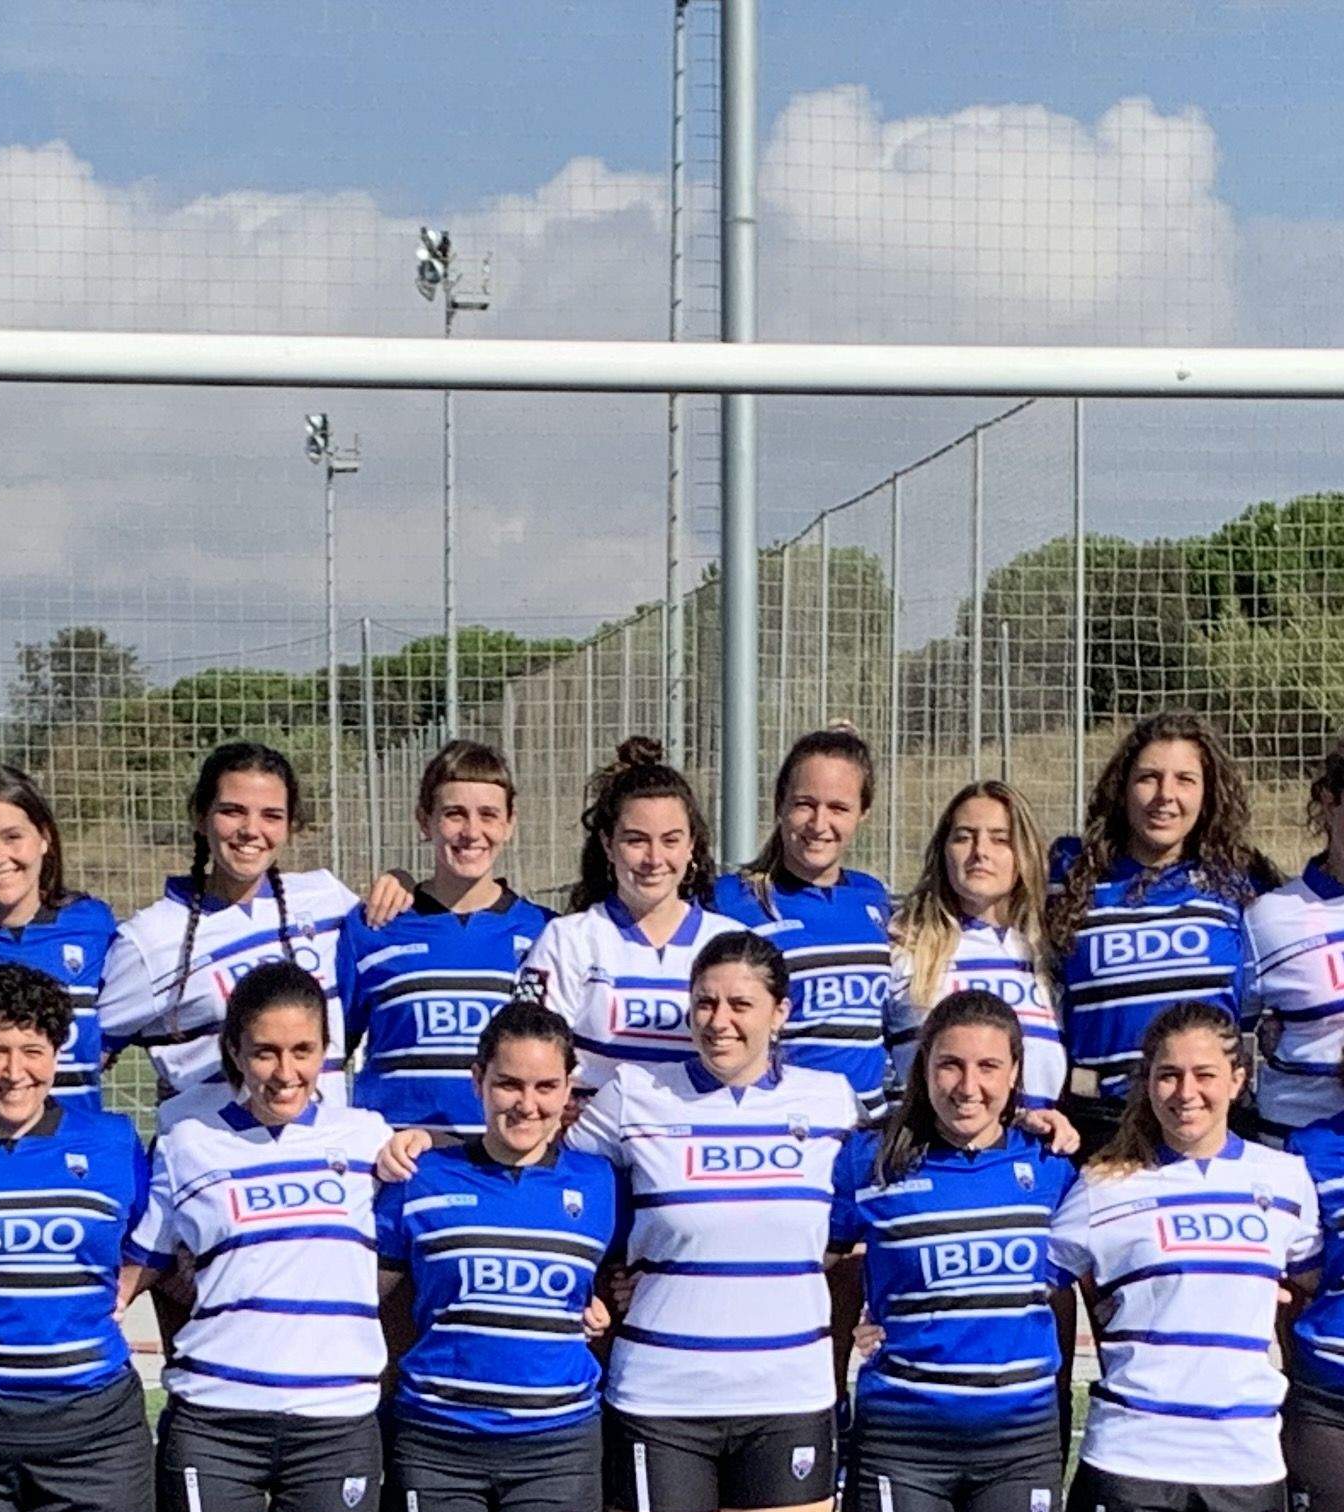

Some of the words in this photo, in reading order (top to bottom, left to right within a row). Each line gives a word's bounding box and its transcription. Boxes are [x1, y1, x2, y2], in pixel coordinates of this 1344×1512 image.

[1104, 925, 1209, 964] BDO
[817, 975, 890, 1008] BDO
[428, 1001, 503, 1034] BD
[625, 999, 691, 1030] BD
[702, 1144, 803, 1171] BDO
[246, 1180, 346, 1210] BDO
[1173, 1214, 1268, 1242] BDO
[938, 1238, 1037, 1274] BDO
[474, 1258, 576, 1297] BDO
